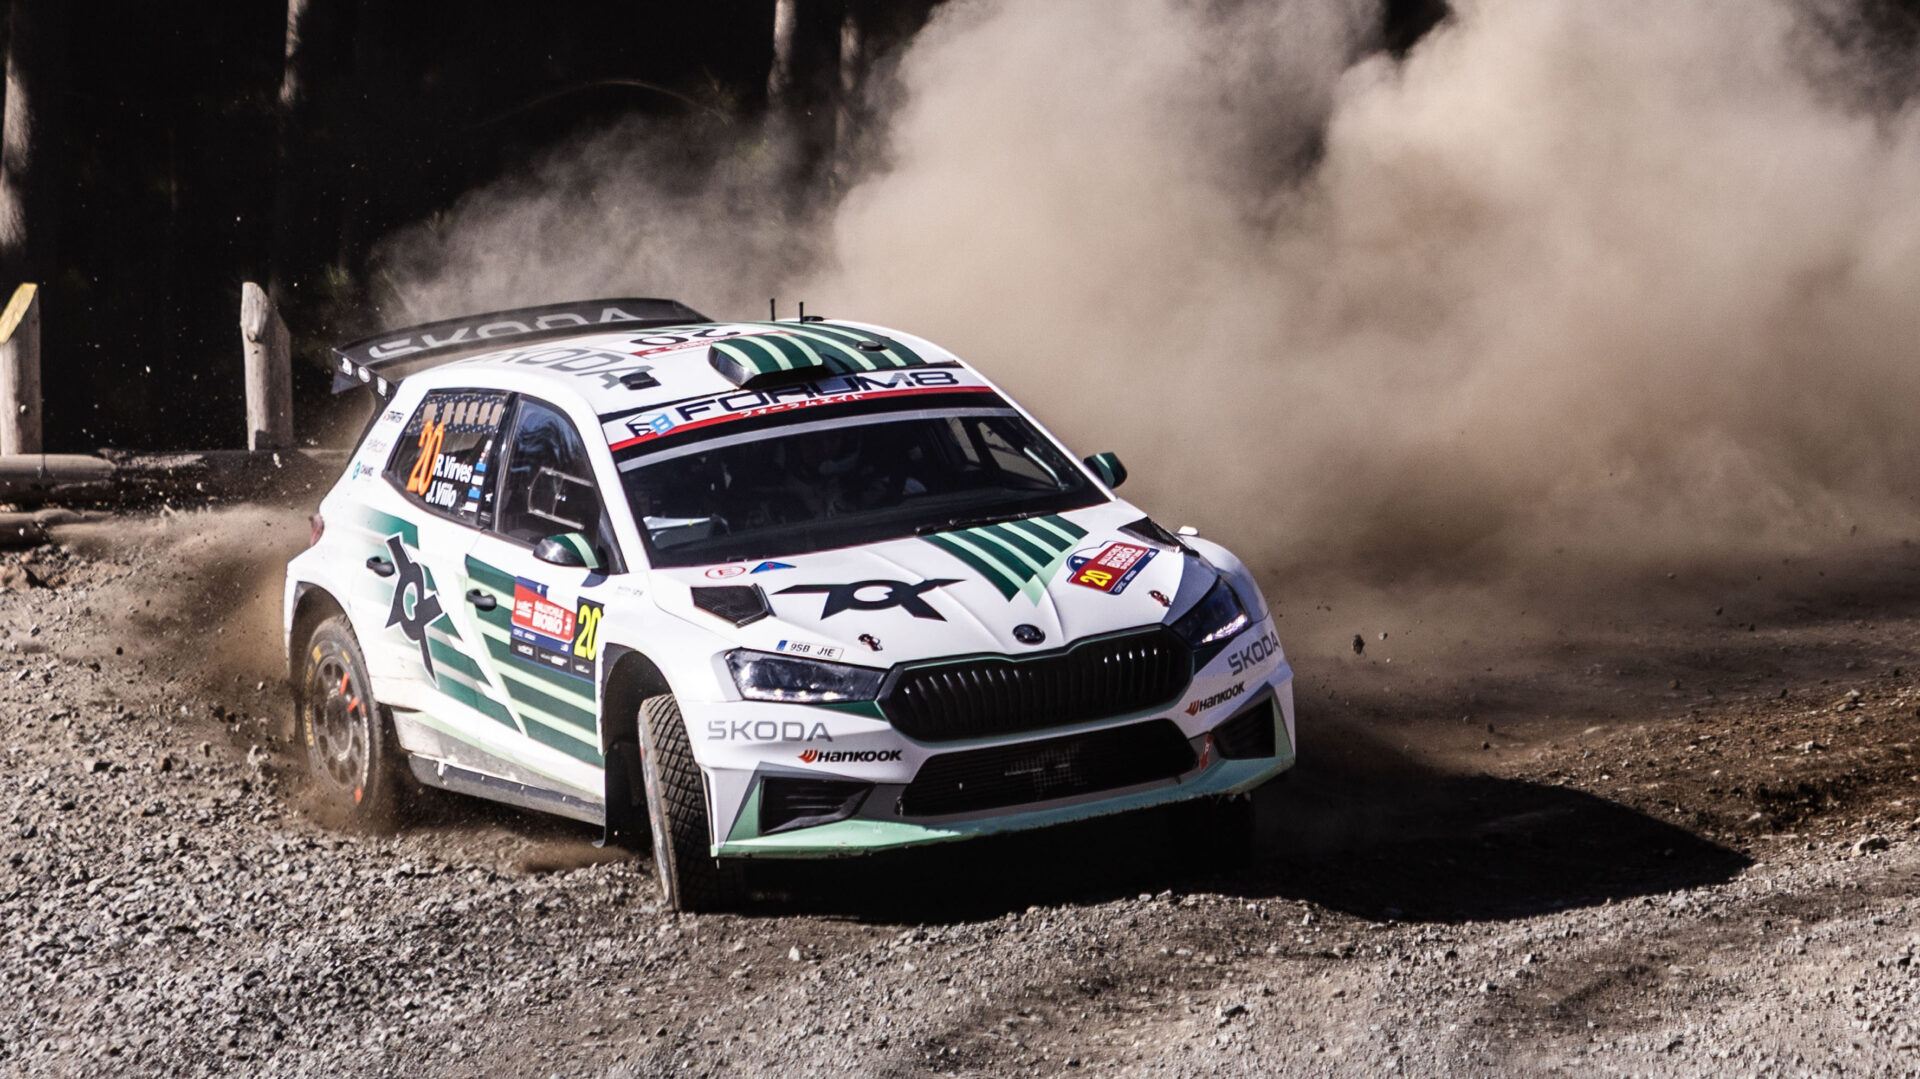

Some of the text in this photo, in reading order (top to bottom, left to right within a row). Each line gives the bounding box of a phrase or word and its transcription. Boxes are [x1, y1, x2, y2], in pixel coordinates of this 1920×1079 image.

[675, 371, 959, 421] FORUM8
[406, 420, 444, 496] 20
[433, 453, 474, 483] R.Virves
[1080, 569, 1113, 587] 20
[574, 604, 603, 660] 20
